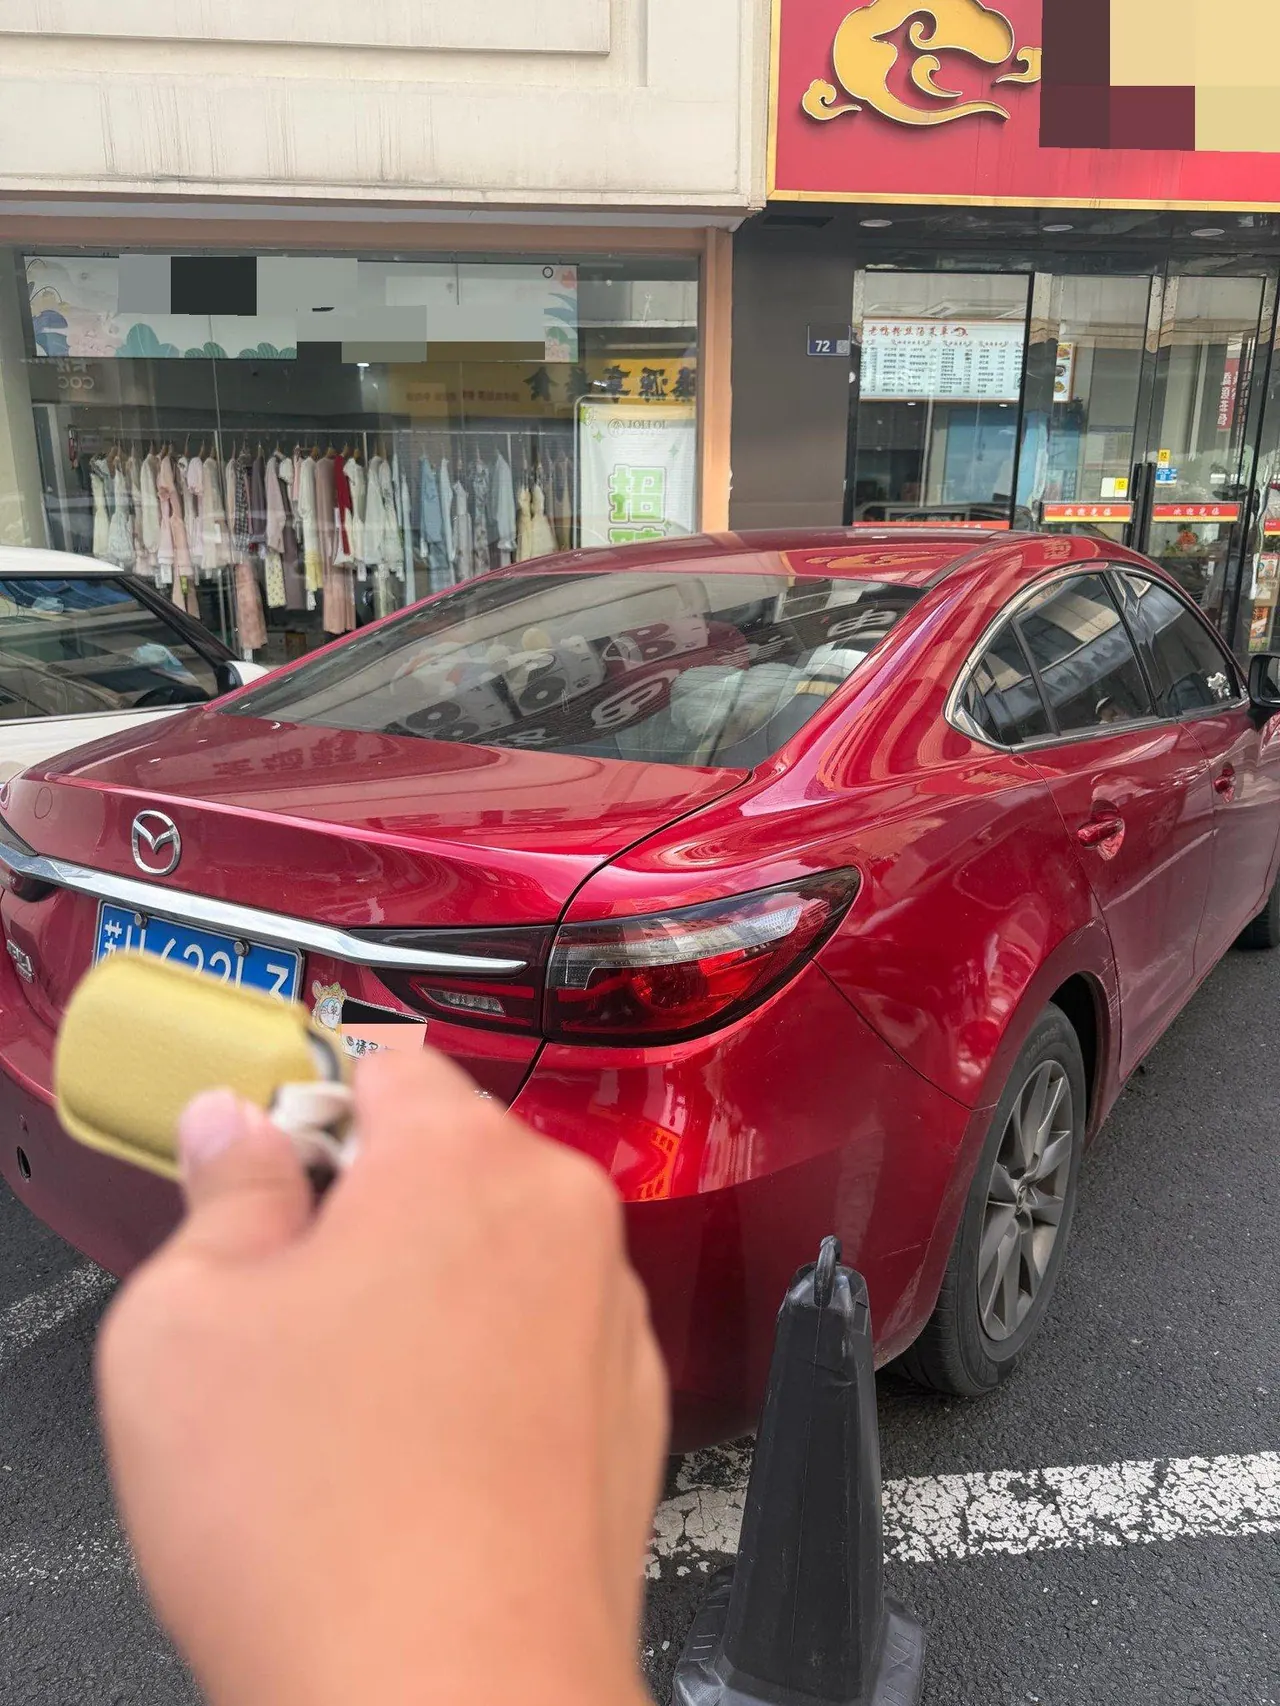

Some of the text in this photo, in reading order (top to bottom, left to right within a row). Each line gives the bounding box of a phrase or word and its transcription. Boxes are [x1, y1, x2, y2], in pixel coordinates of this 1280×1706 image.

[815, 340, 830, 352] 72
[608, 464, 666, 545] 招
[1063, 506, 1112, 517] 欢迎光临
[1172, 506, 1220, 517] 欢迎光临
